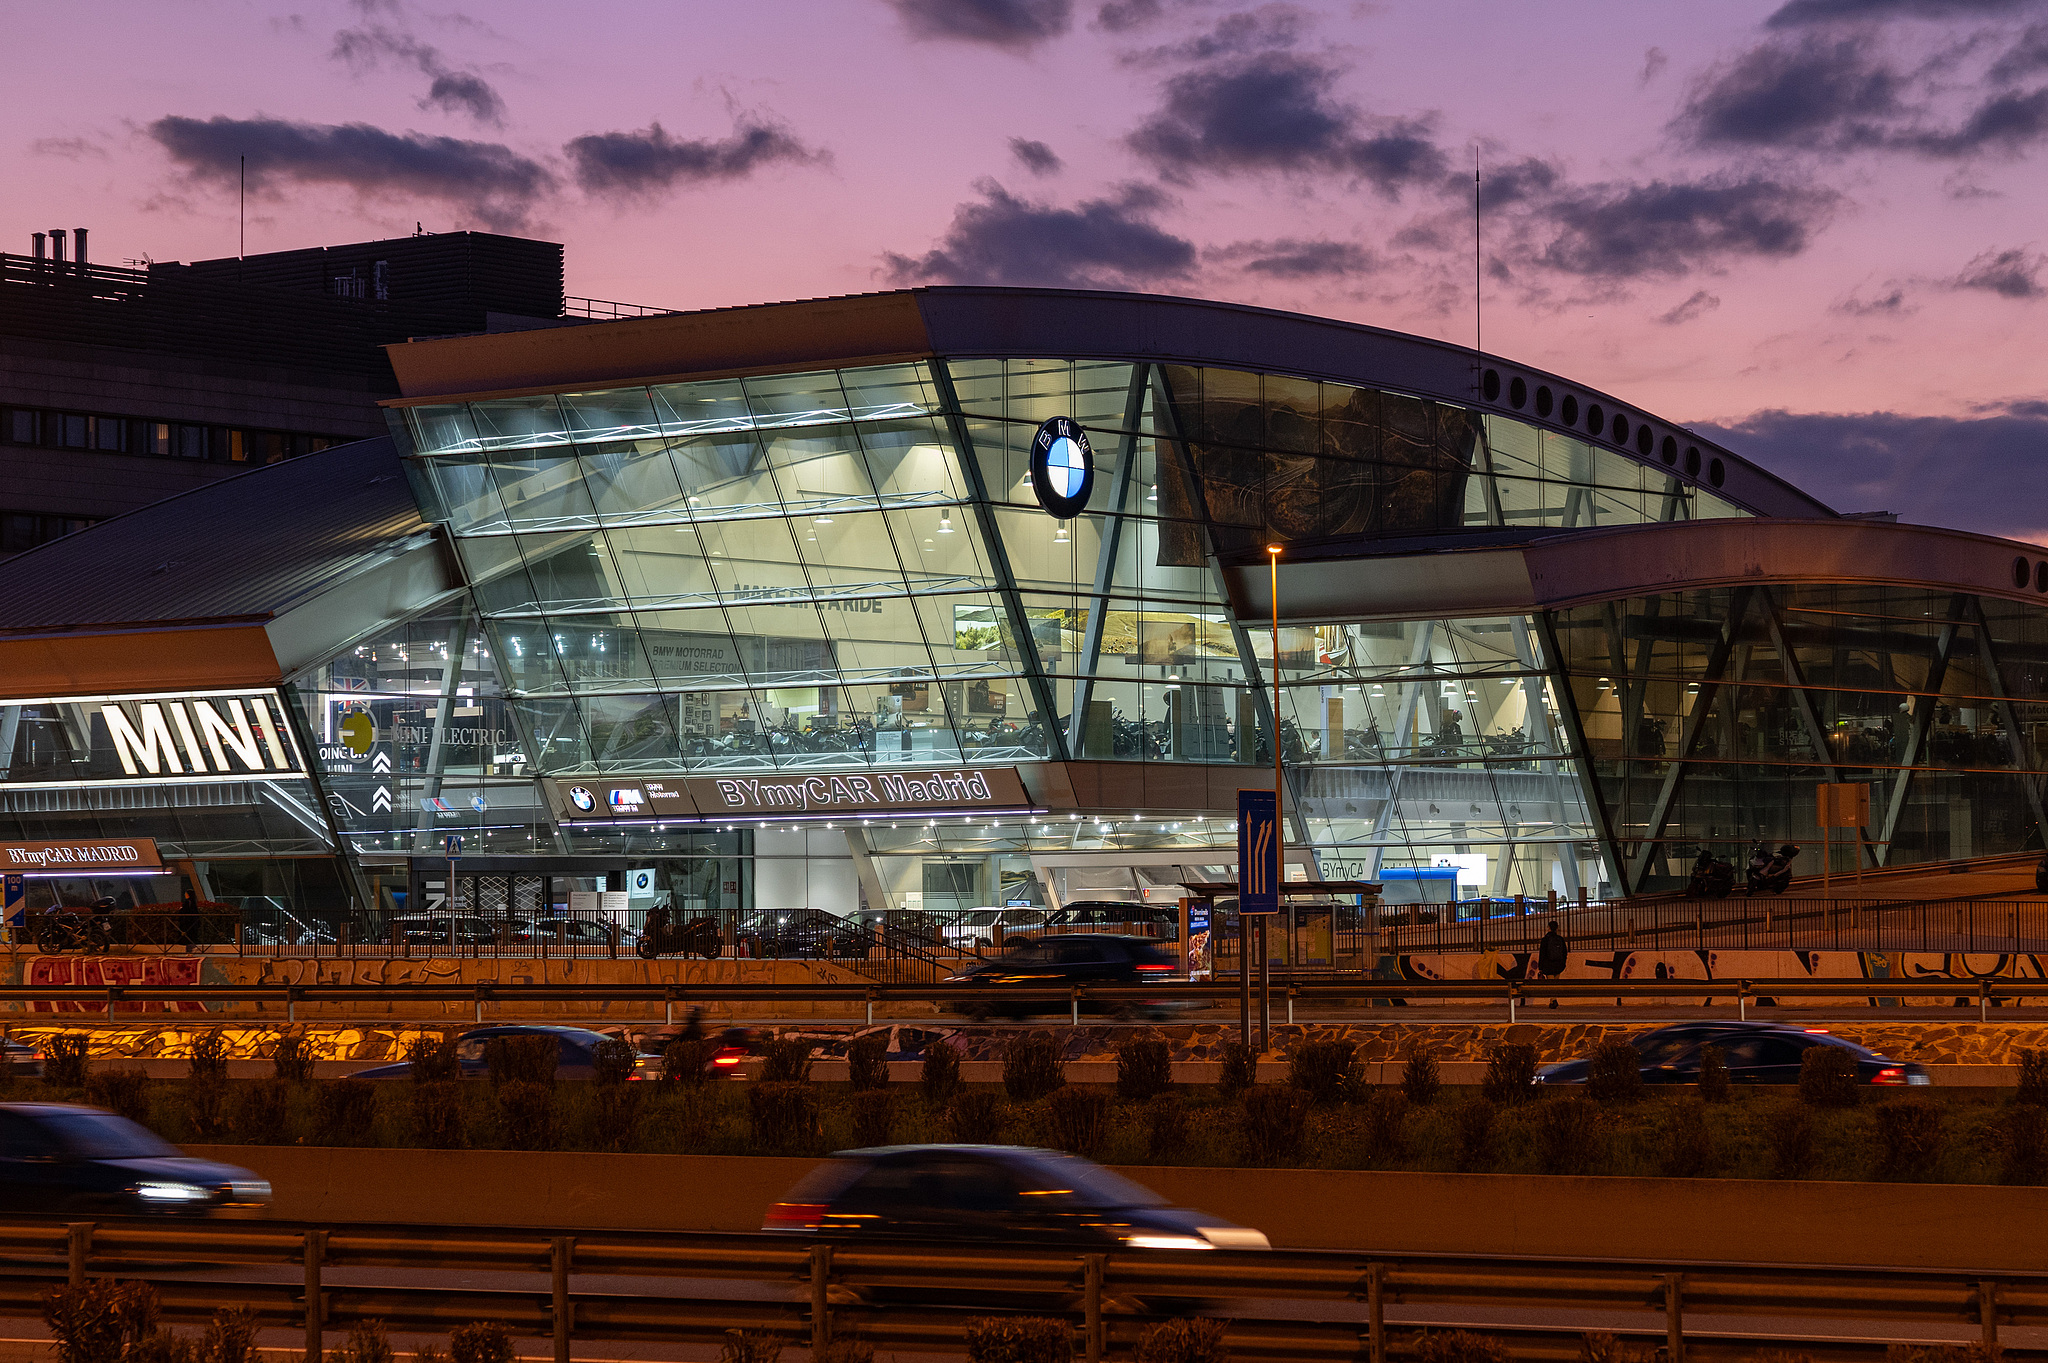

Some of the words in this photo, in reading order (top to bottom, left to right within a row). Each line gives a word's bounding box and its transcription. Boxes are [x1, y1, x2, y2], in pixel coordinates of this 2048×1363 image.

[1038, 419, 1090, 455] BMW
[734, 584, 786, 608] MAKE
[828, 591, 841, 611] A
[843, 591, 882, 613] RIDE
[653, 646, 674, 656] BMW
[675, 647, 724, 659] MOTORRAD
[653, 659, 692, 672] PREMIUM
[693, 661, 742, 673] SELECTION
[100, 697, 290, 775] MINI
[389, 725, 428, 744] MINI
[716, 777, 880, 811] BYmyCAR
[877, 771, 992, 803] Madrid
[6, 847, 77, 867] BYmyCAR
[73, 845, 138, 862] MADRID
[7, 876, 21, 884] 100
